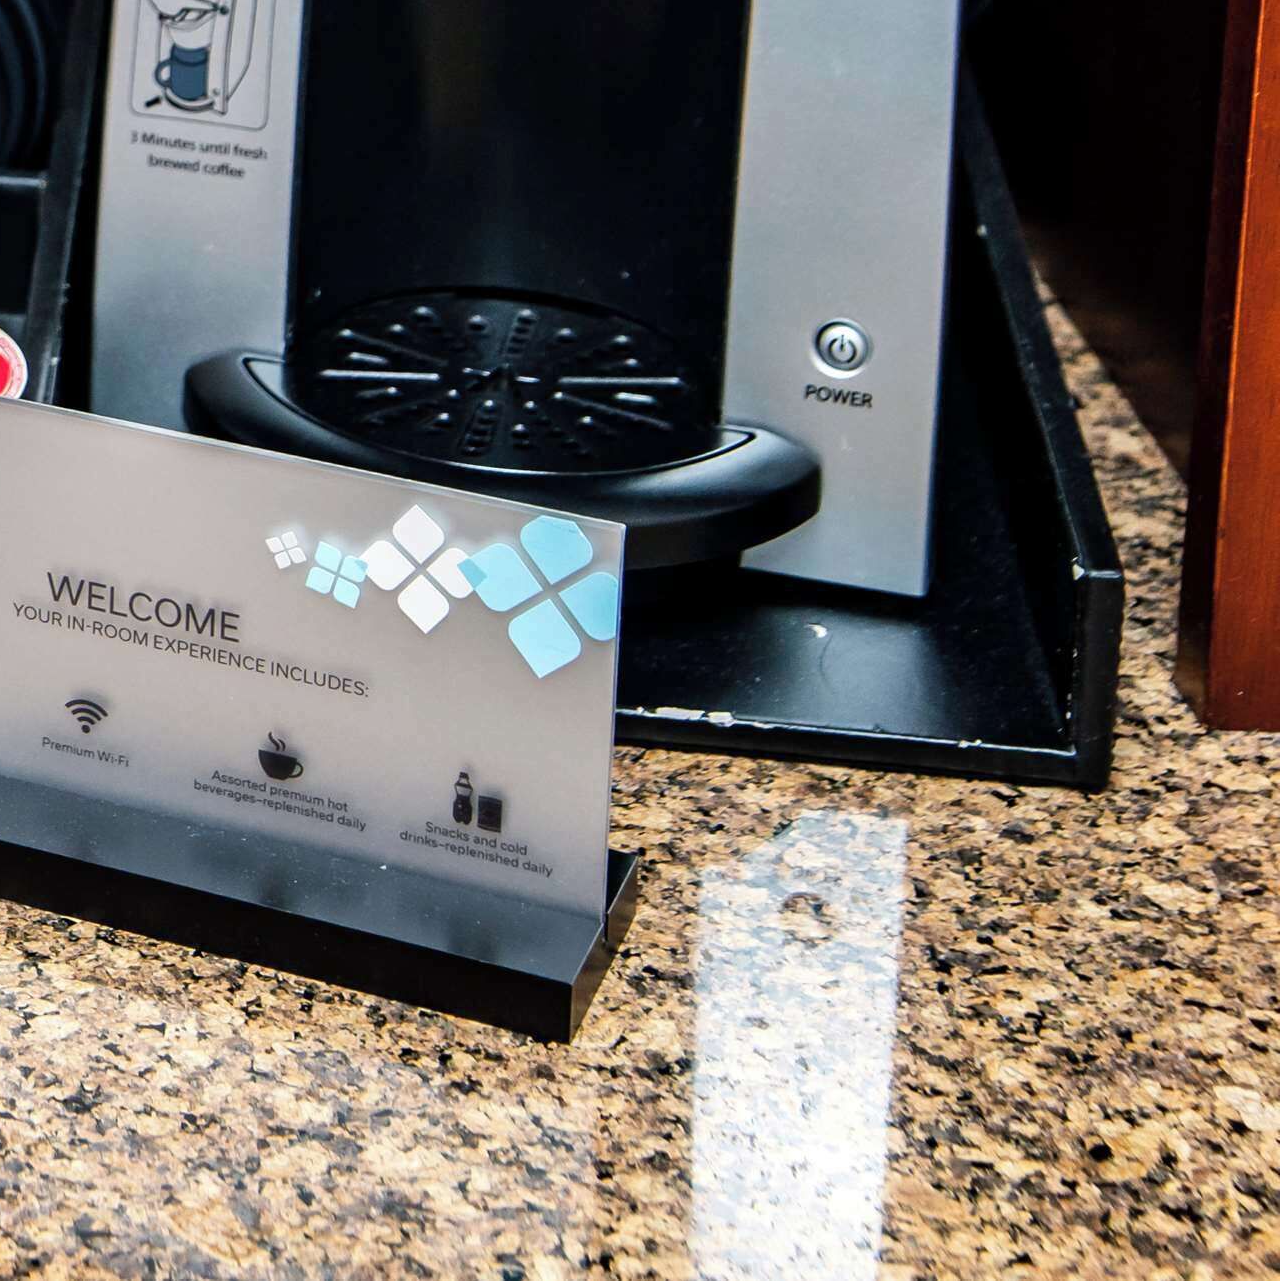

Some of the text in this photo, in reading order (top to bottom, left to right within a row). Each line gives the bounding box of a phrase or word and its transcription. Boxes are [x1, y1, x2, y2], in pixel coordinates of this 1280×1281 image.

[141, 132, 197, 151] Minutes
[199, 142, 231, 155] until
[232, 144, 269, 160] fresh
[147, 154, 246, 179] brewed coffee
[803, 383, 874, 409] POWER
[46, 570, 241, 644] WELCOME
[12, 601, 370, 699] YOUR IN-ROOM EXPERIENCE INCLUDES:
[41, 736, 131, 768] Premium Wi-Fi
[210, 769, 349, 813] Assorted premium hot
[336, 813, 367, 833] daily
[425, 821, 529, 857] Snacks and cold
[521, 858, 555, 880] daily
